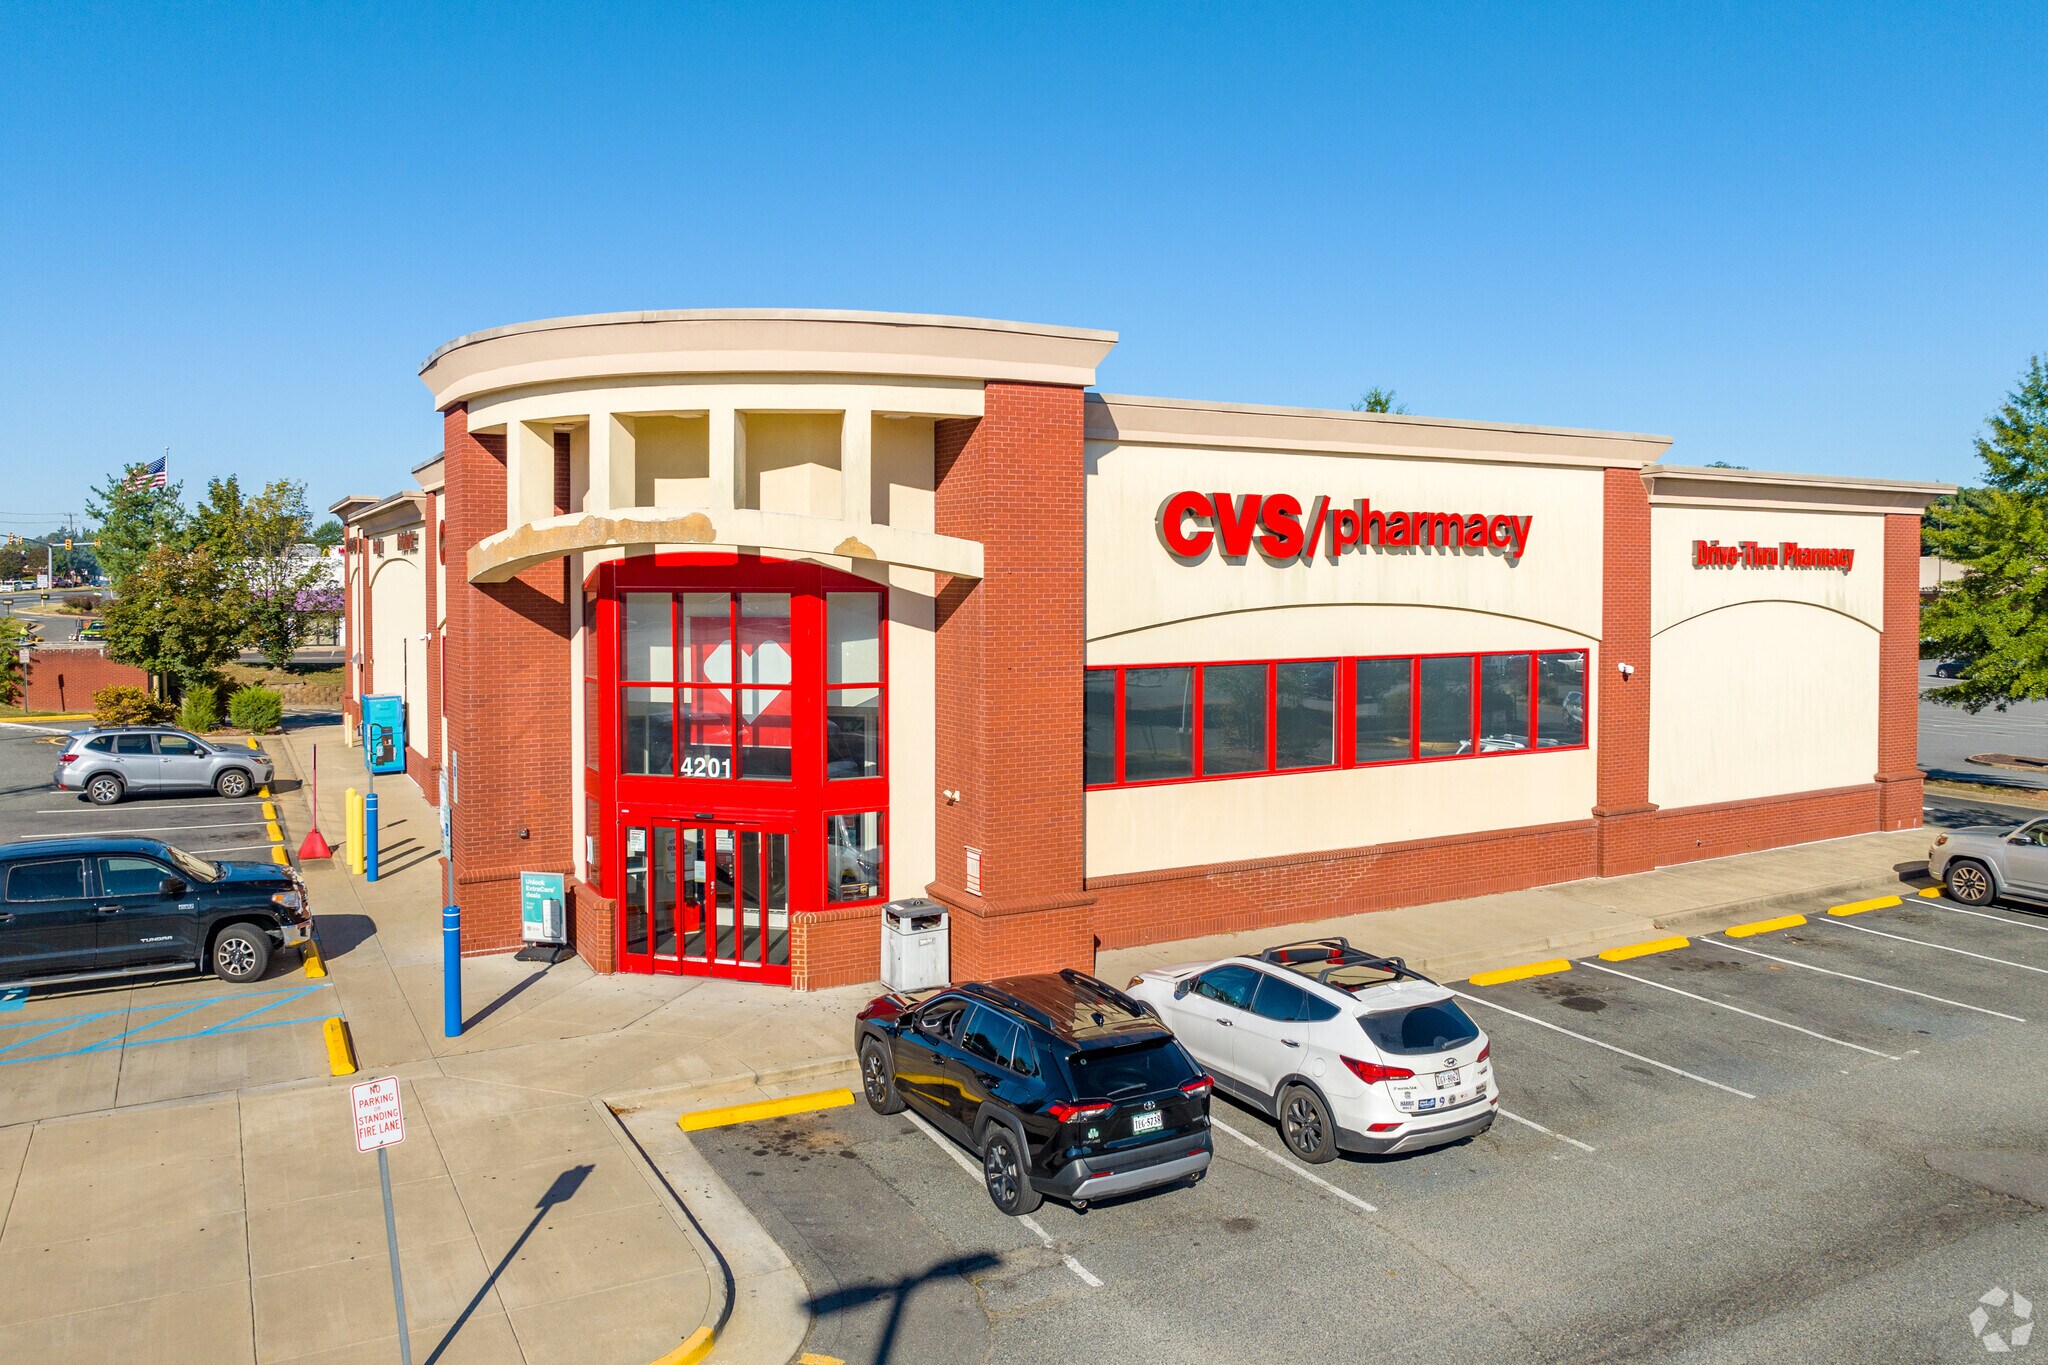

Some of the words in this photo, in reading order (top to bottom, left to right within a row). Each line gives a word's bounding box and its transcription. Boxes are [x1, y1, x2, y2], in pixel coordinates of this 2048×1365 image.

[1692, 540, 1778, 570] Drive-Thru
[1779, 542, 1855, 575] Pharmacy
[680, 756, 731, 779] 4201
[525, 878, 546, 886] Unlock
[140, 935, 173, 943] TUNDRA
[369, 1084, 381, 1095] NO
[358, 1092, 394, 1108] PARKING
[358, 1108, 399, 1126] STANDING
[359, 1124, 377, 1139] FIRE
[379, 1118, 400, 1134] LANE
